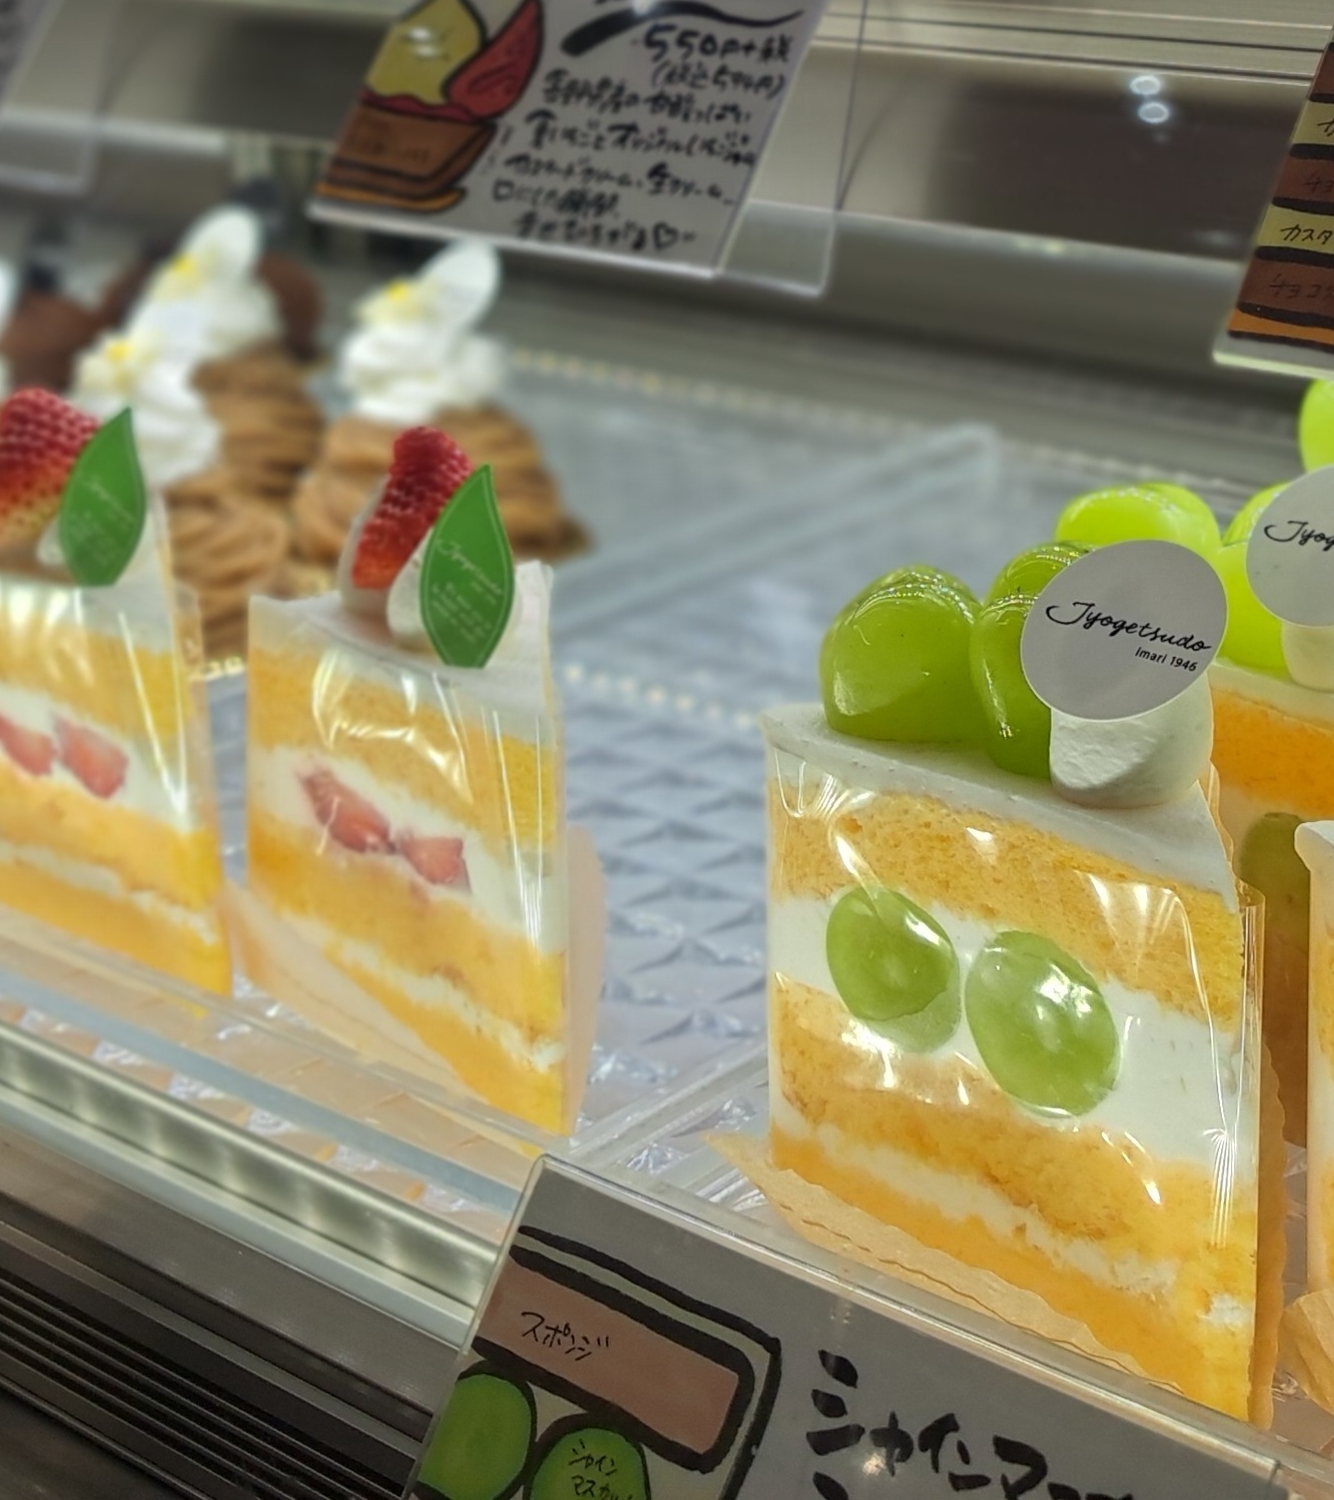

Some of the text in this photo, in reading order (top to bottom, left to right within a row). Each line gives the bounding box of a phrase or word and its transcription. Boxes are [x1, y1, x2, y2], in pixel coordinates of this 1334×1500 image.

[1045, 601, 1212, 653] Jyogetsudo
[1134, 646, 1199, 672] imari 1946
[521, 1311, 610, 1361] スポンジ
[806, 1349, 1134, 1500] シャインマ
[568, 1438, 618, 1476] シャイン
